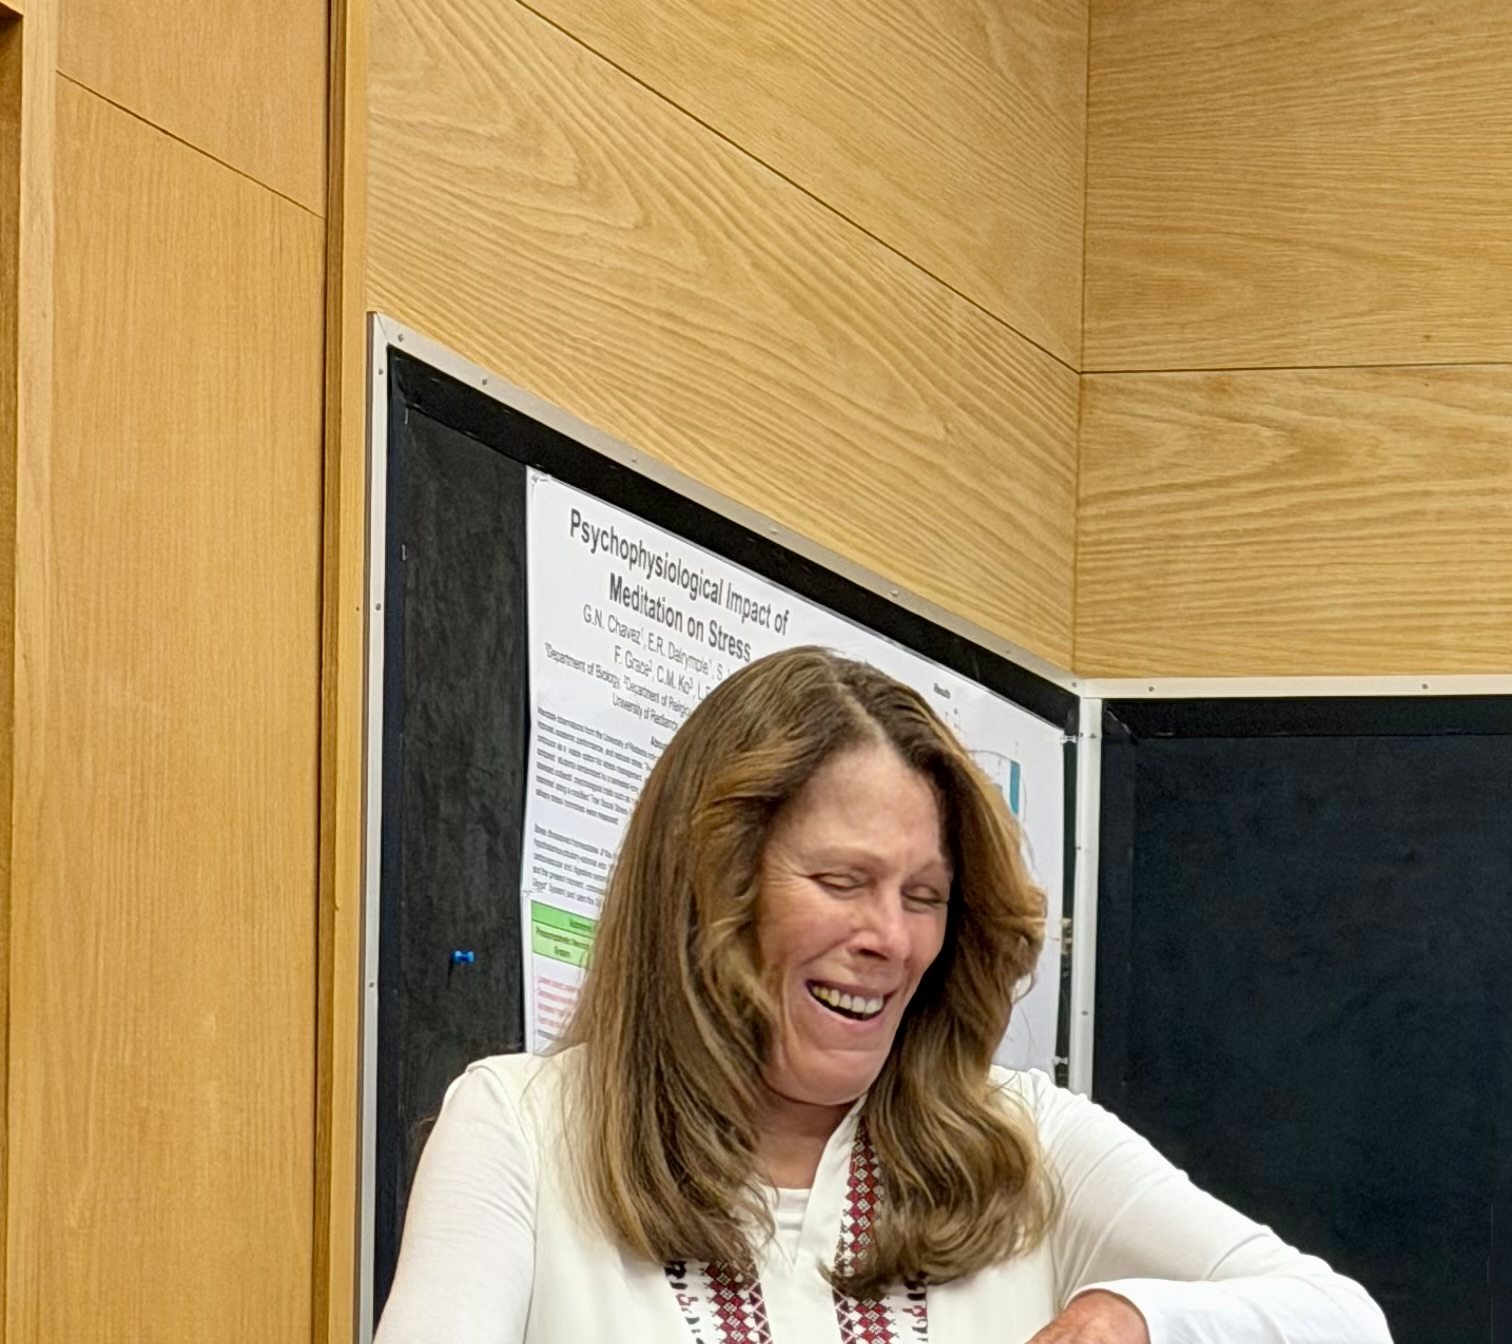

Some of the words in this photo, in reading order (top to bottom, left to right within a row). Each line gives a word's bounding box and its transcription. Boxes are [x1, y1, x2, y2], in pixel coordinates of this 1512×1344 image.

[569, 507, 724, 605] Psychophysiological
[725, 582, 772, 629] Impact
[774, 609, 790, 636] of
[609, 572, 684, 633] Meditation
[686, 616, 704, 643] on
[707, 619, 752, 663] Stress
